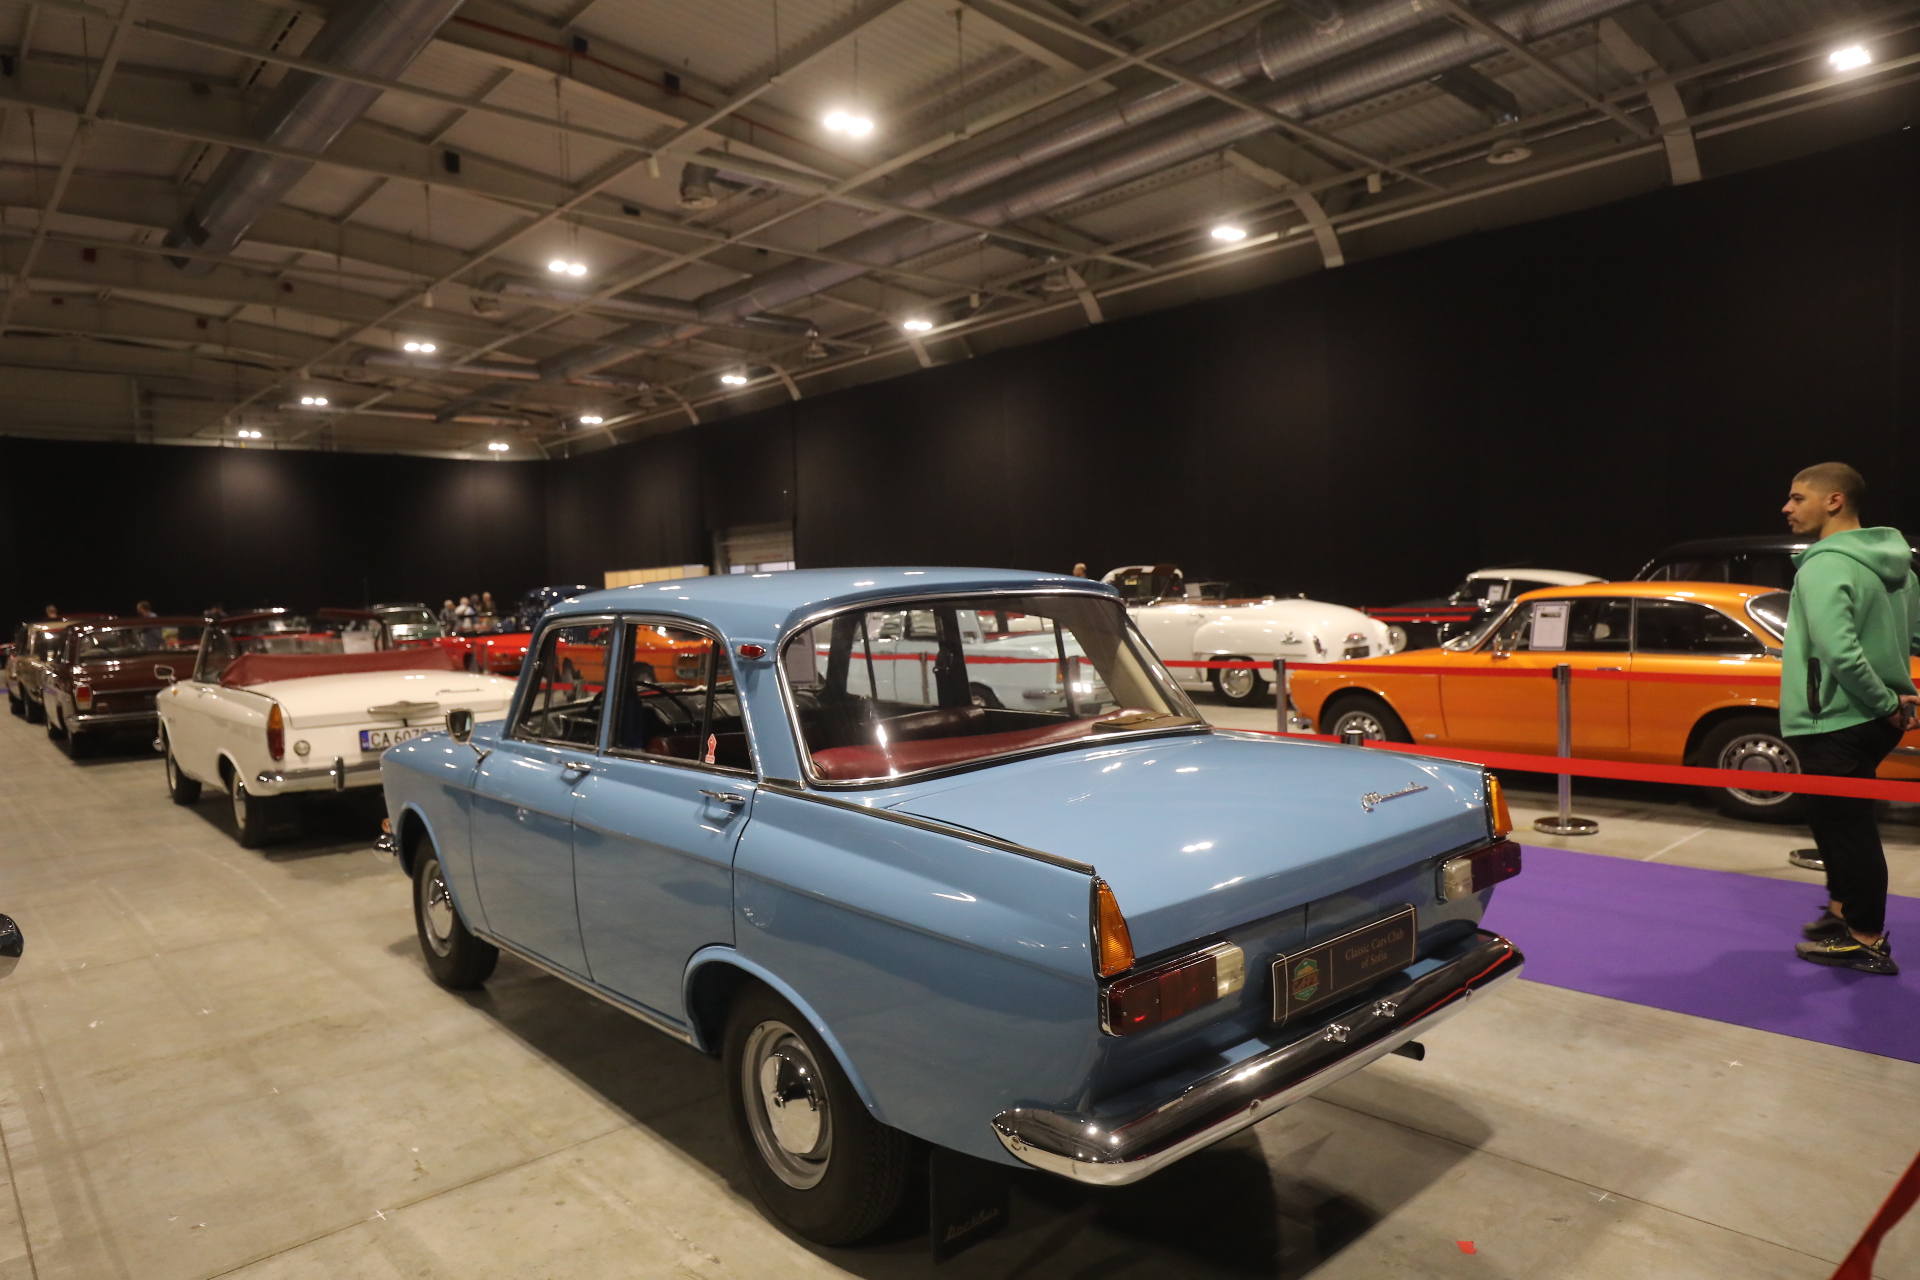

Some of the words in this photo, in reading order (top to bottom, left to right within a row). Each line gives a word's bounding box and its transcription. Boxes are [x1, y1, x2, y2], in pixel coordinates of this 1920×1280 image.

[1345, 943, 1370, 960] Classic
[1371, 938, 1387, 949] Cars
[1387, 928, 1404, 943] Club
[1361, 956, 1369, 969] of
[1370, 950, 1387, 964] Sofia
